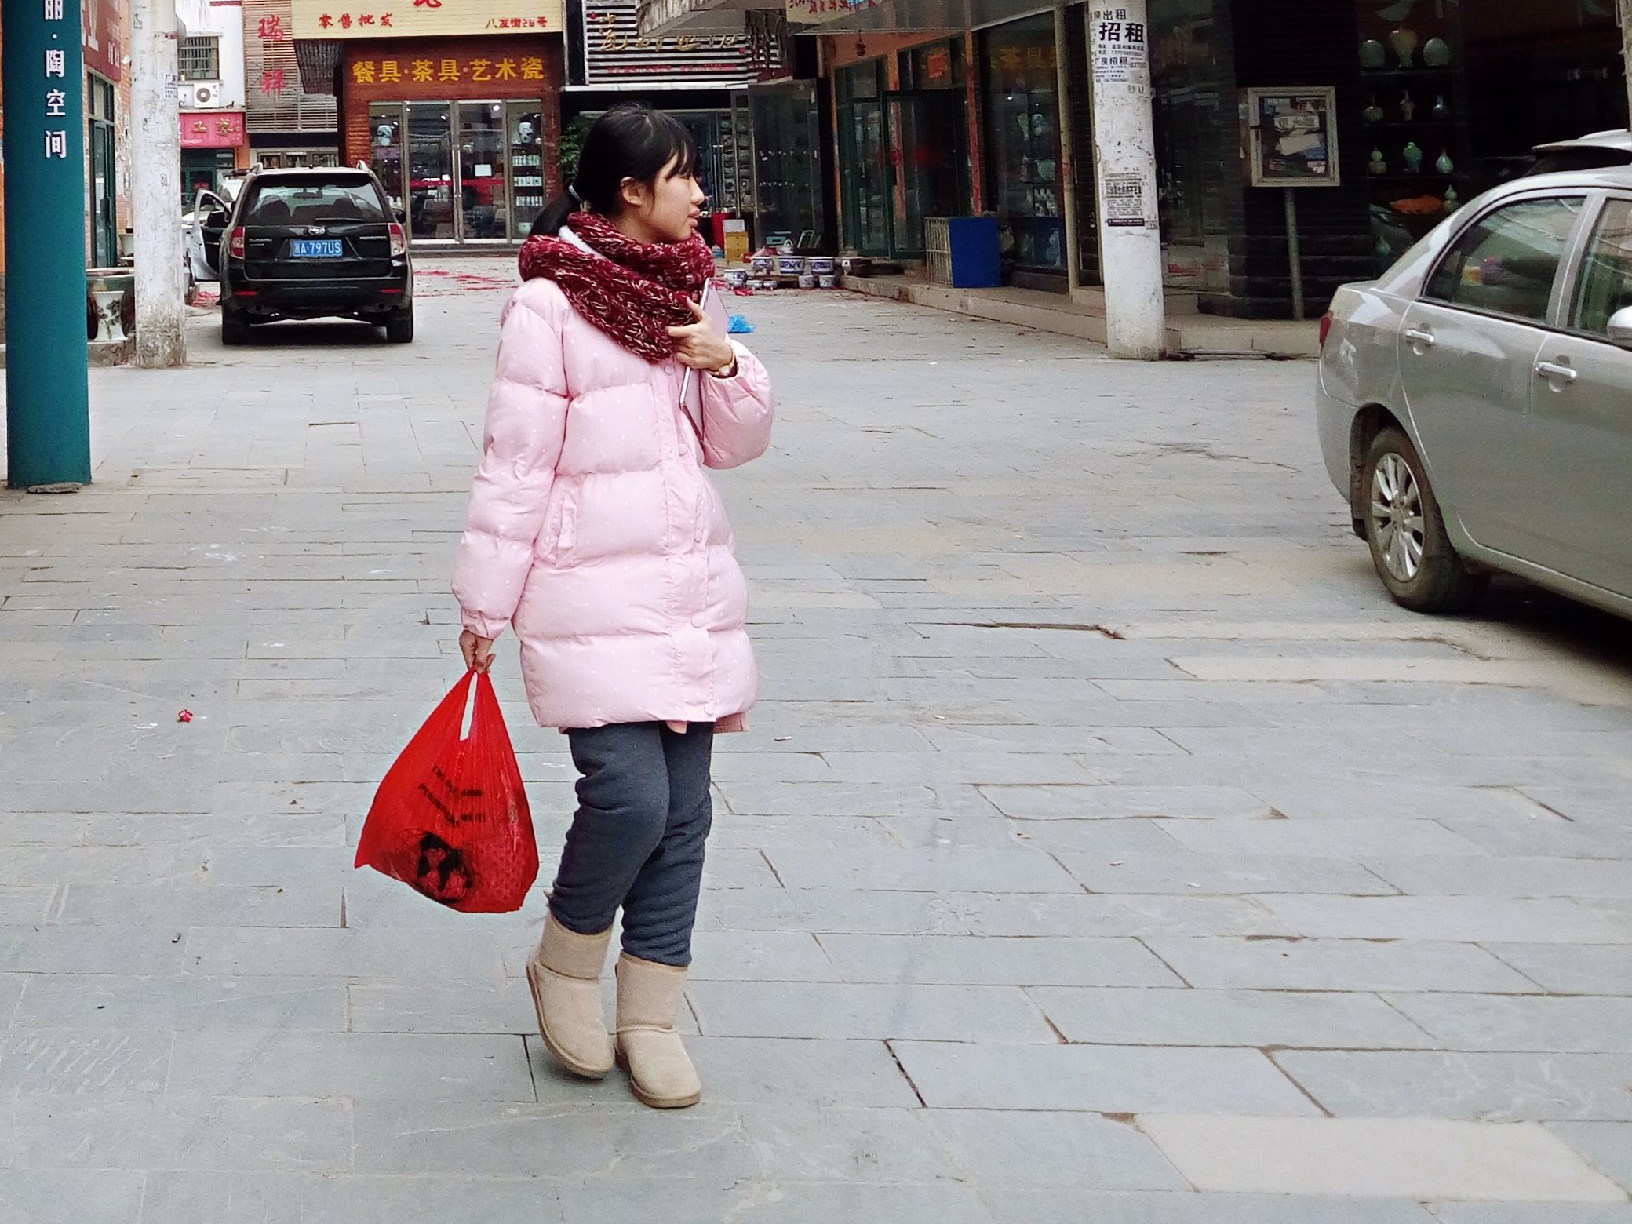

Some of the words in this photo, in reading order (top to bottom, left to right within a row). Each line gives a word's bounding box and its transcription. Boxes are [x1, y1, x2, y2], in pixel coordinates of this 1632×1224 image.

[319, 12, 393, 29] 零售批发
[1098, 22, 1144, 43] 招租
[352, 56, 545, 84] 餐具·茶具·艺术瓷
